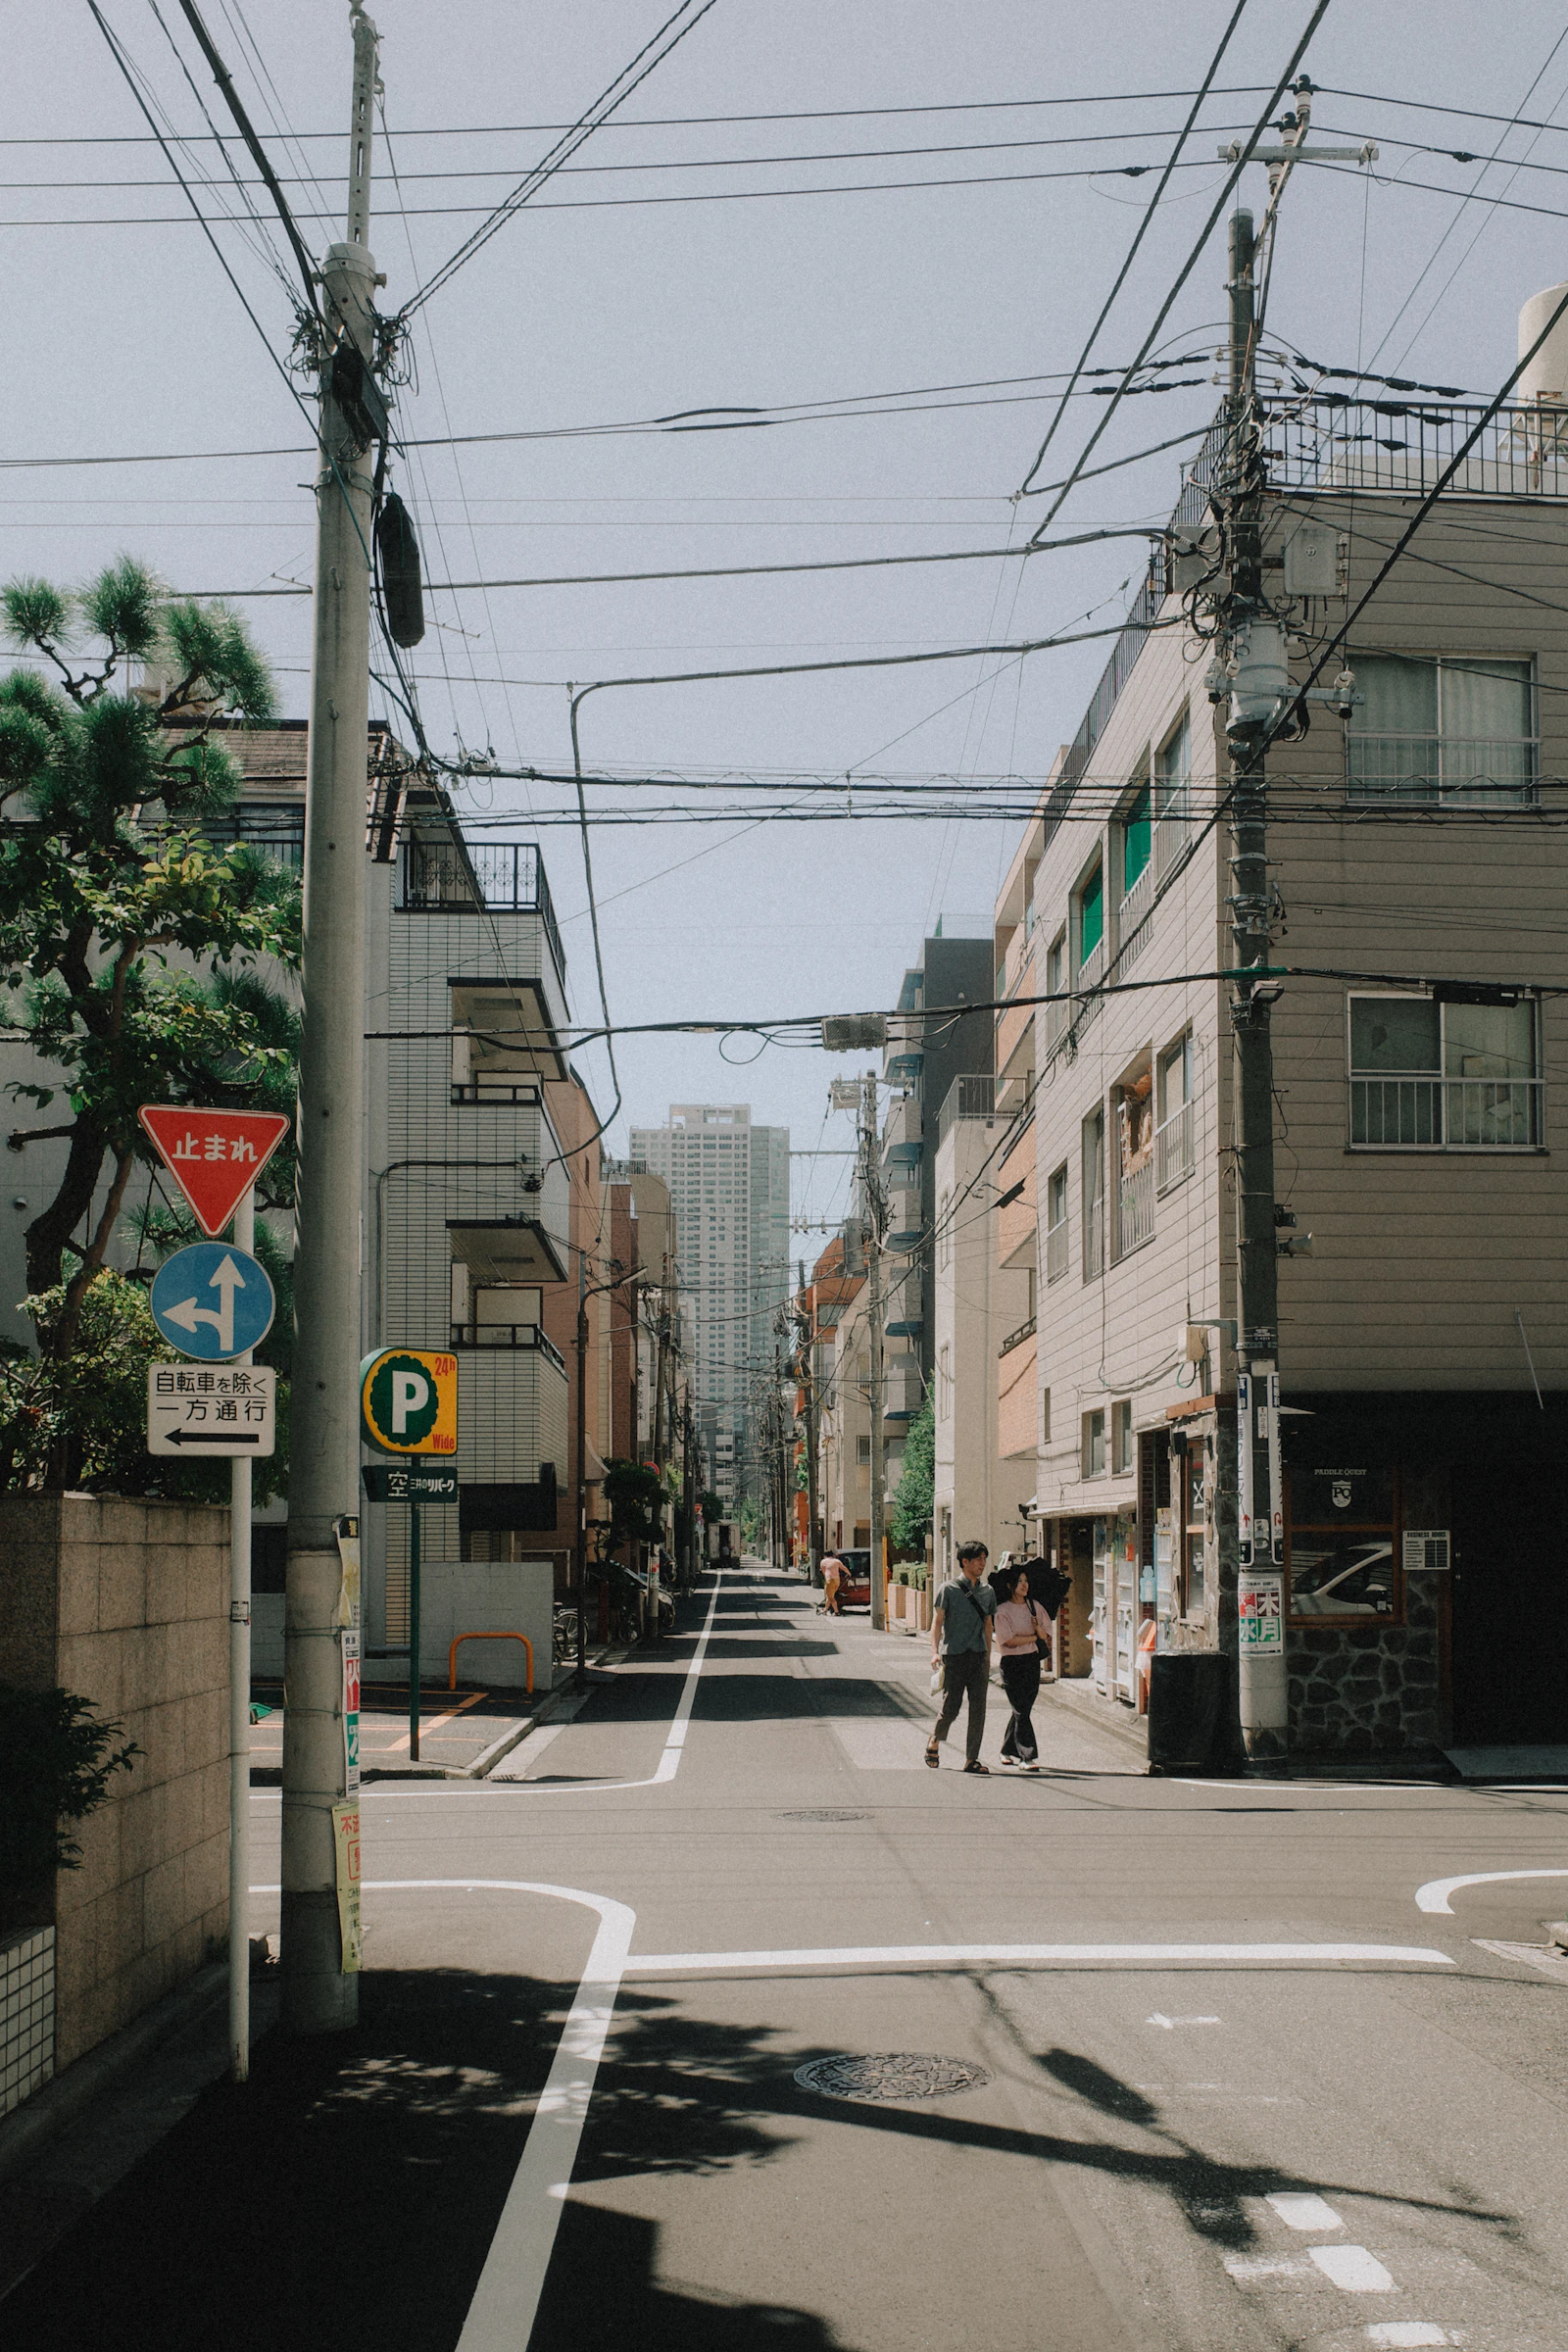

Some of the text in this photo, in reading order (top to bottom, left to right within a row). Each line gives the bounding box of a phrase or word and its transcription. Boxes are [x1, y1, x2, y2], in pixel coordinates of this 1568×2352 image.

[172, 1132, 259, 1163] 止まれ
[435, 1356, 456, 1377] 24h
[156, 1370, 267, 1395] 自転車を除く
[156, 1399, 268, 1422] 一方通行
[392, 1370, 429, 1434] P
[432, 1434, 455, 1450] Wide
[387, 1471, 409, 1497] 空
[1344, 1467, 1367, 1477] QUEST
[1333, 1487, 1351, 1500] PQ
[1257, 1592, 1280, 1617] 木
[1258, 1618, 1279, 1642] 月
